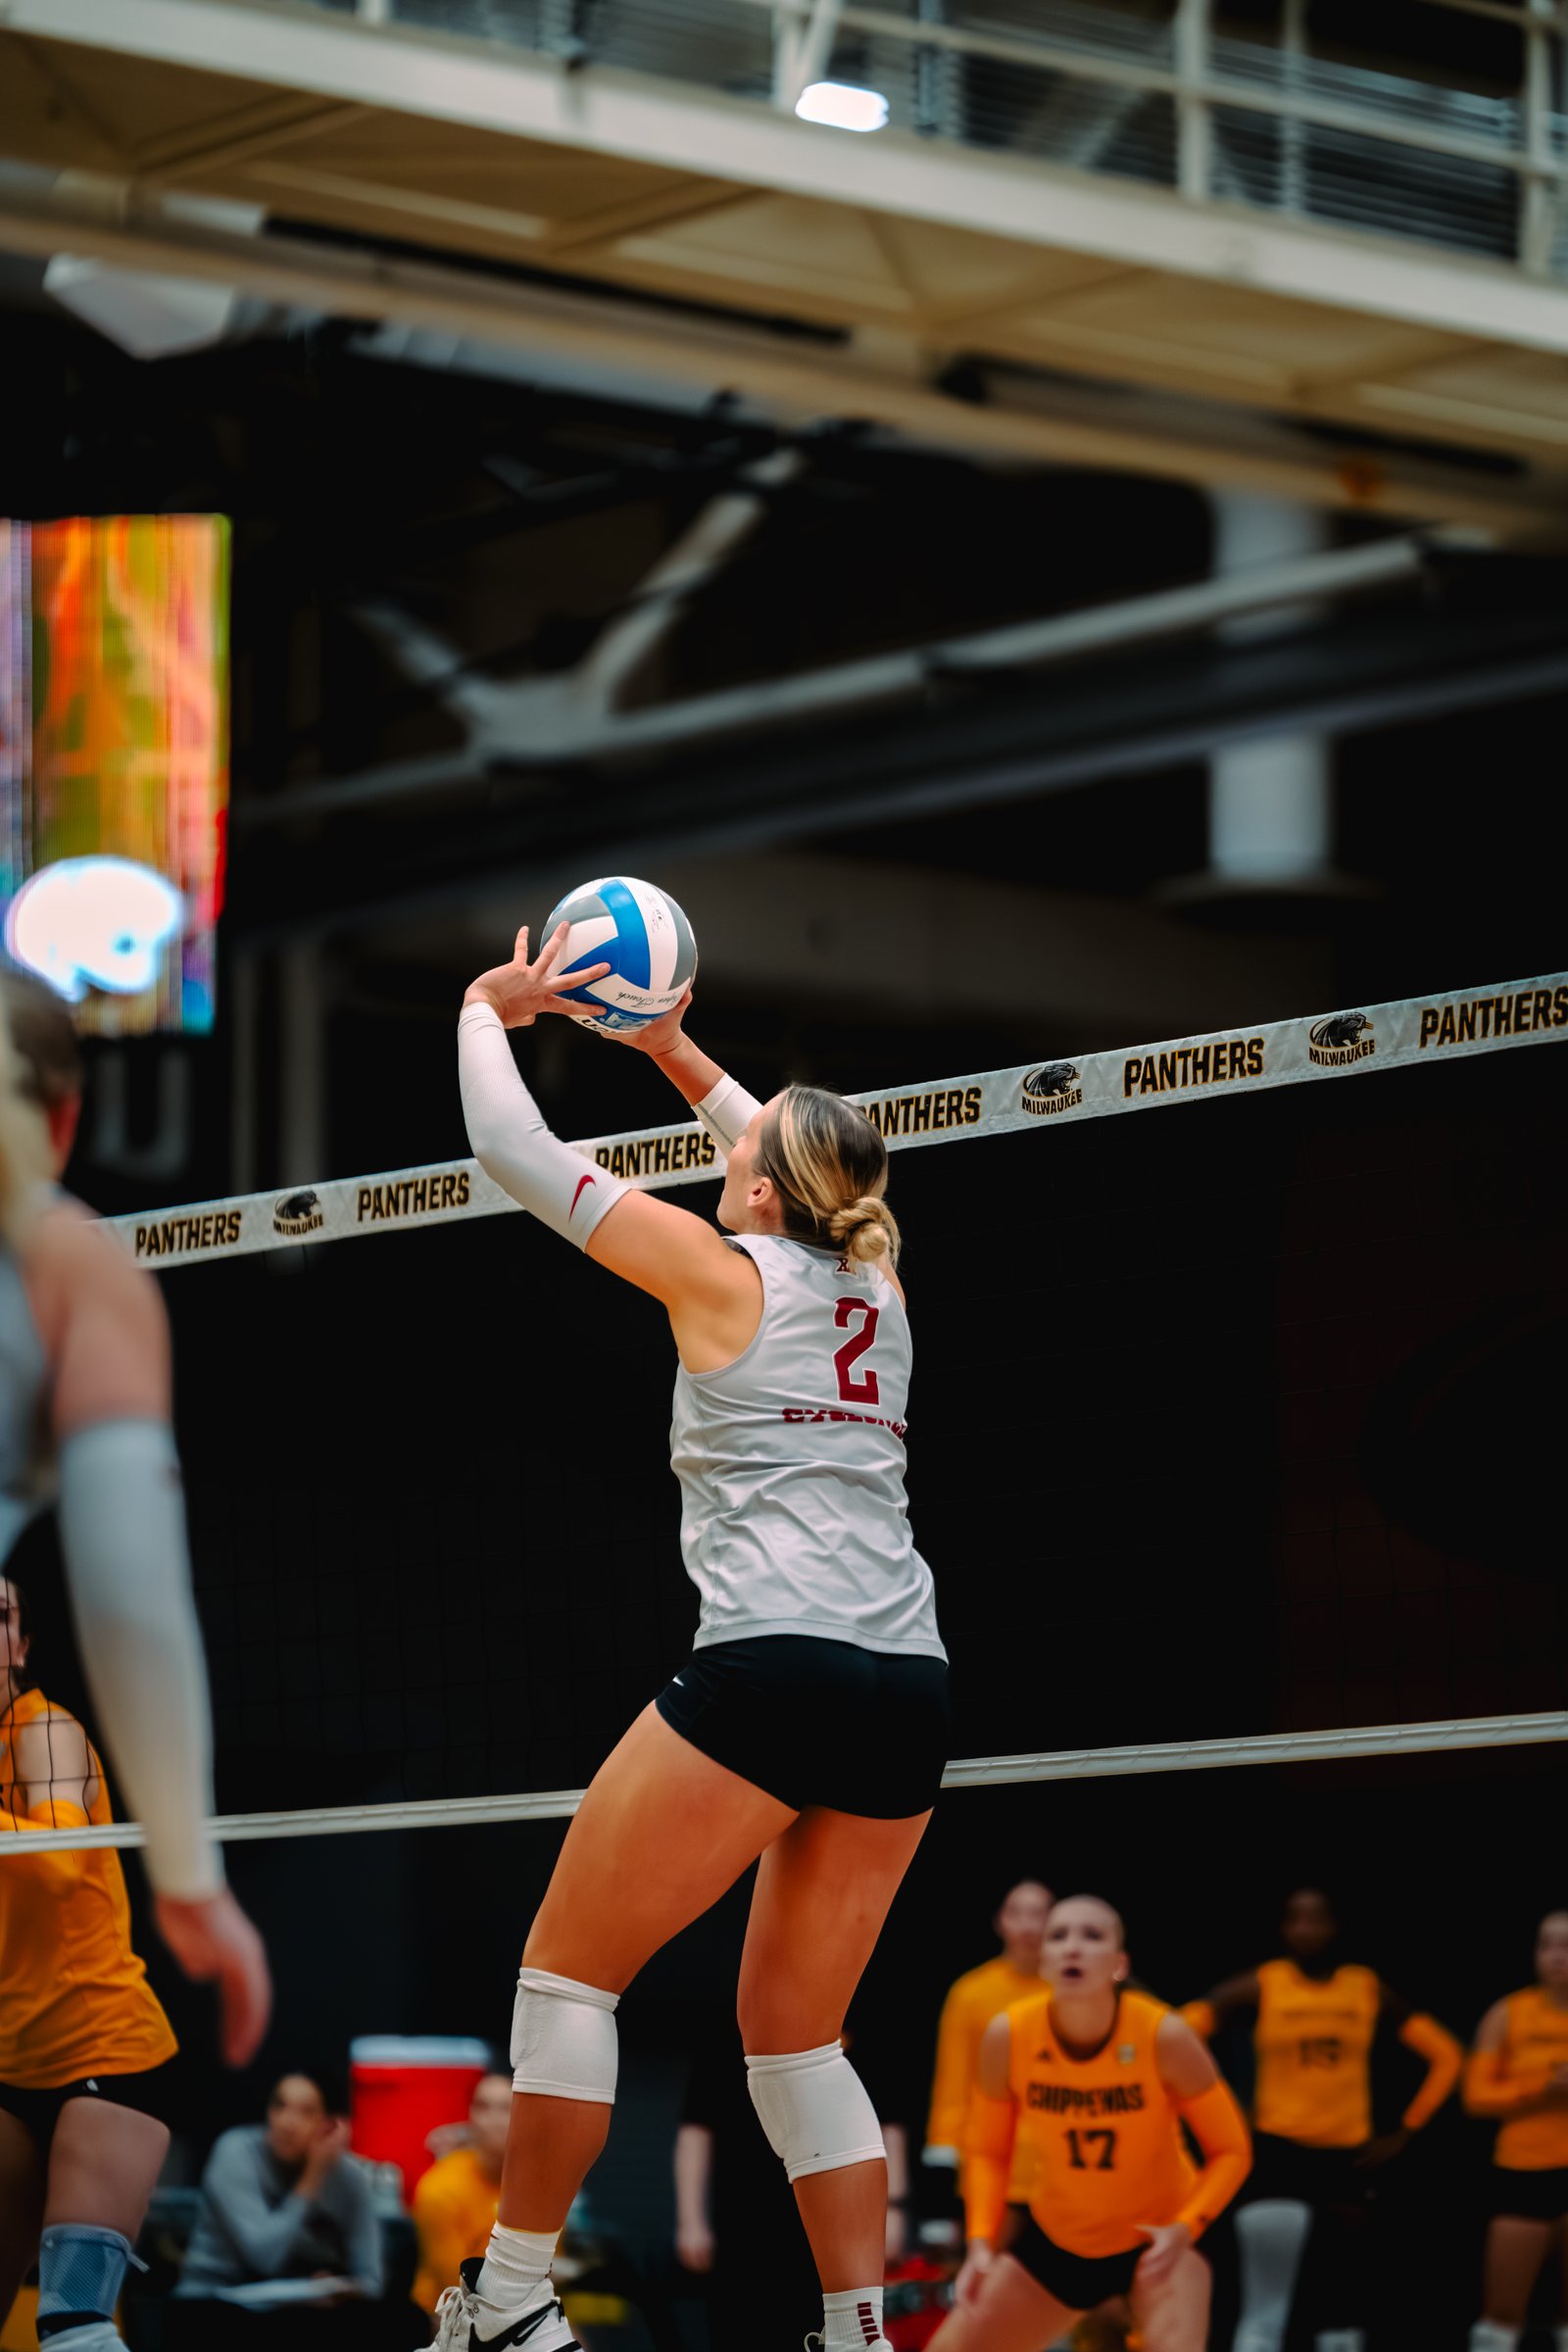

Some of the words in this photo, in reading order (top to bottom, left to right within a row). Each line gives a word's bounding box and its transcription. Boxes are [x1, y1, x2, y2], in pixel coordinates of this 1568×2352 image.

[615, 992, 655, 1008] Touch
[1418, 986, 1568, 1049] PANTHERS
[1122, 1036, 1266, 1099] PANTHERS
[1309, 1038, 1375, 1066] MILWAUKEE
[858, 1087, 982, 1138] ANTHERS
[1021, 1088, 1082, 1115] MILWAUKEE
[595, 1131, 716, 1179] PANTHERS
[357, 1172, 470, 1223] PANTHERS
[135, 1210, 242, 1257] PANTHERS
[833, 1296, 879, 1407] 2
[1064, 2128, 1117, 2171] 17
